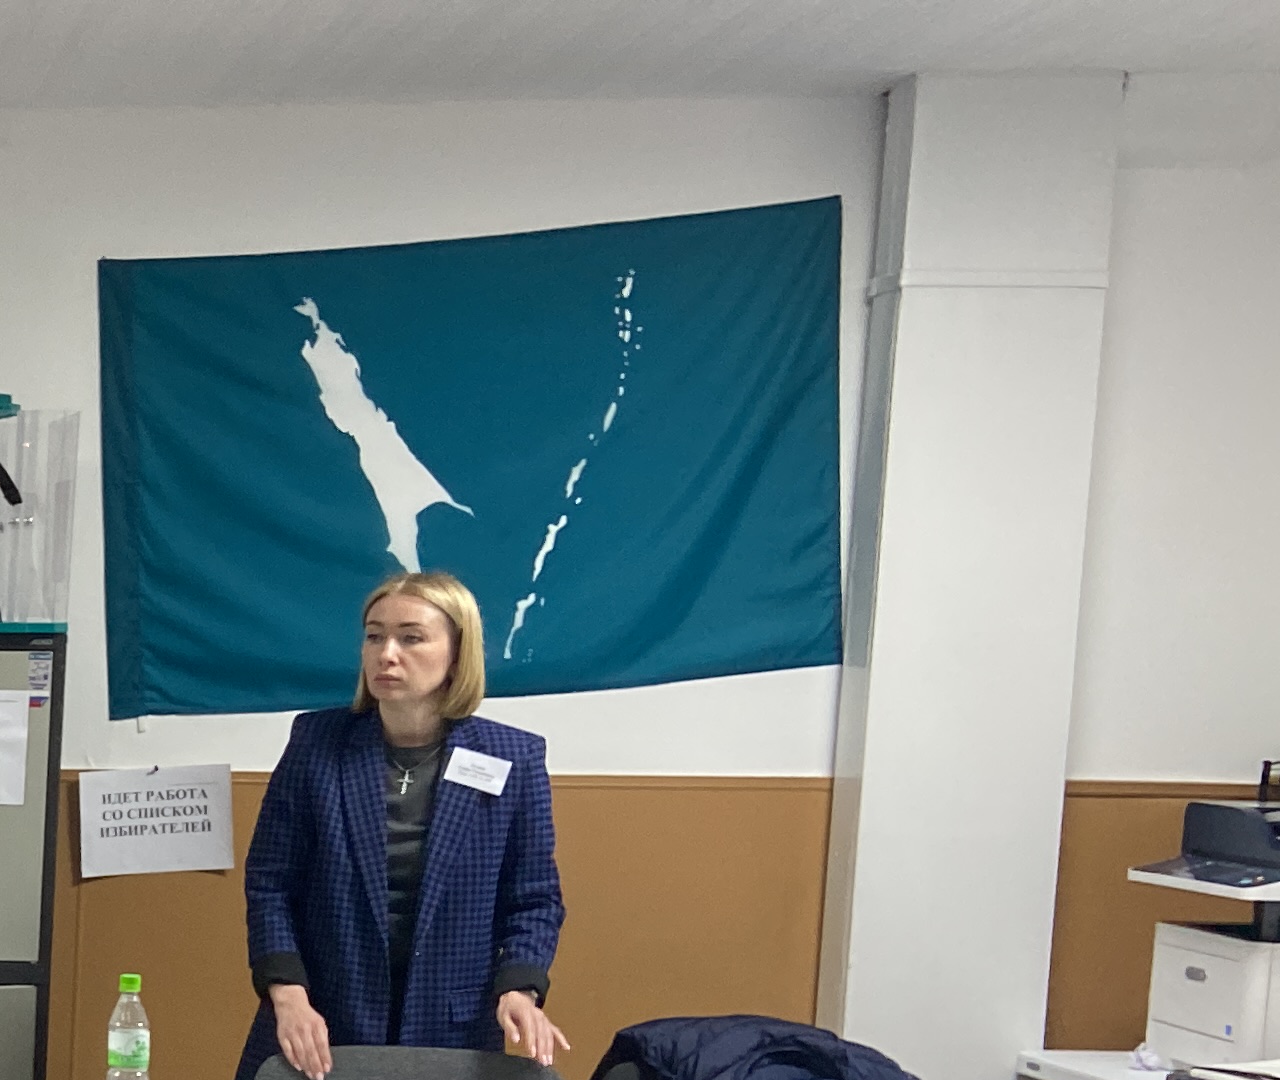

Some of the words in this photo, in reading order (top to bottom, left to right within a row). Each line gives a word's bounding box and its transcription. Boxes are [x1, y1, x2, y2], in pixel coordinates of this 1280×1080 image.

[102, 792, 141, 805] ИДЕТ
[146, 788, 208, 801] РАБОТА
[102, 810, 123, 821] СО
[127, 805, 208, 820] СПИСКОМ
[100, 819, 211, 838] ИЗБИРАТЕЛЕЙ
